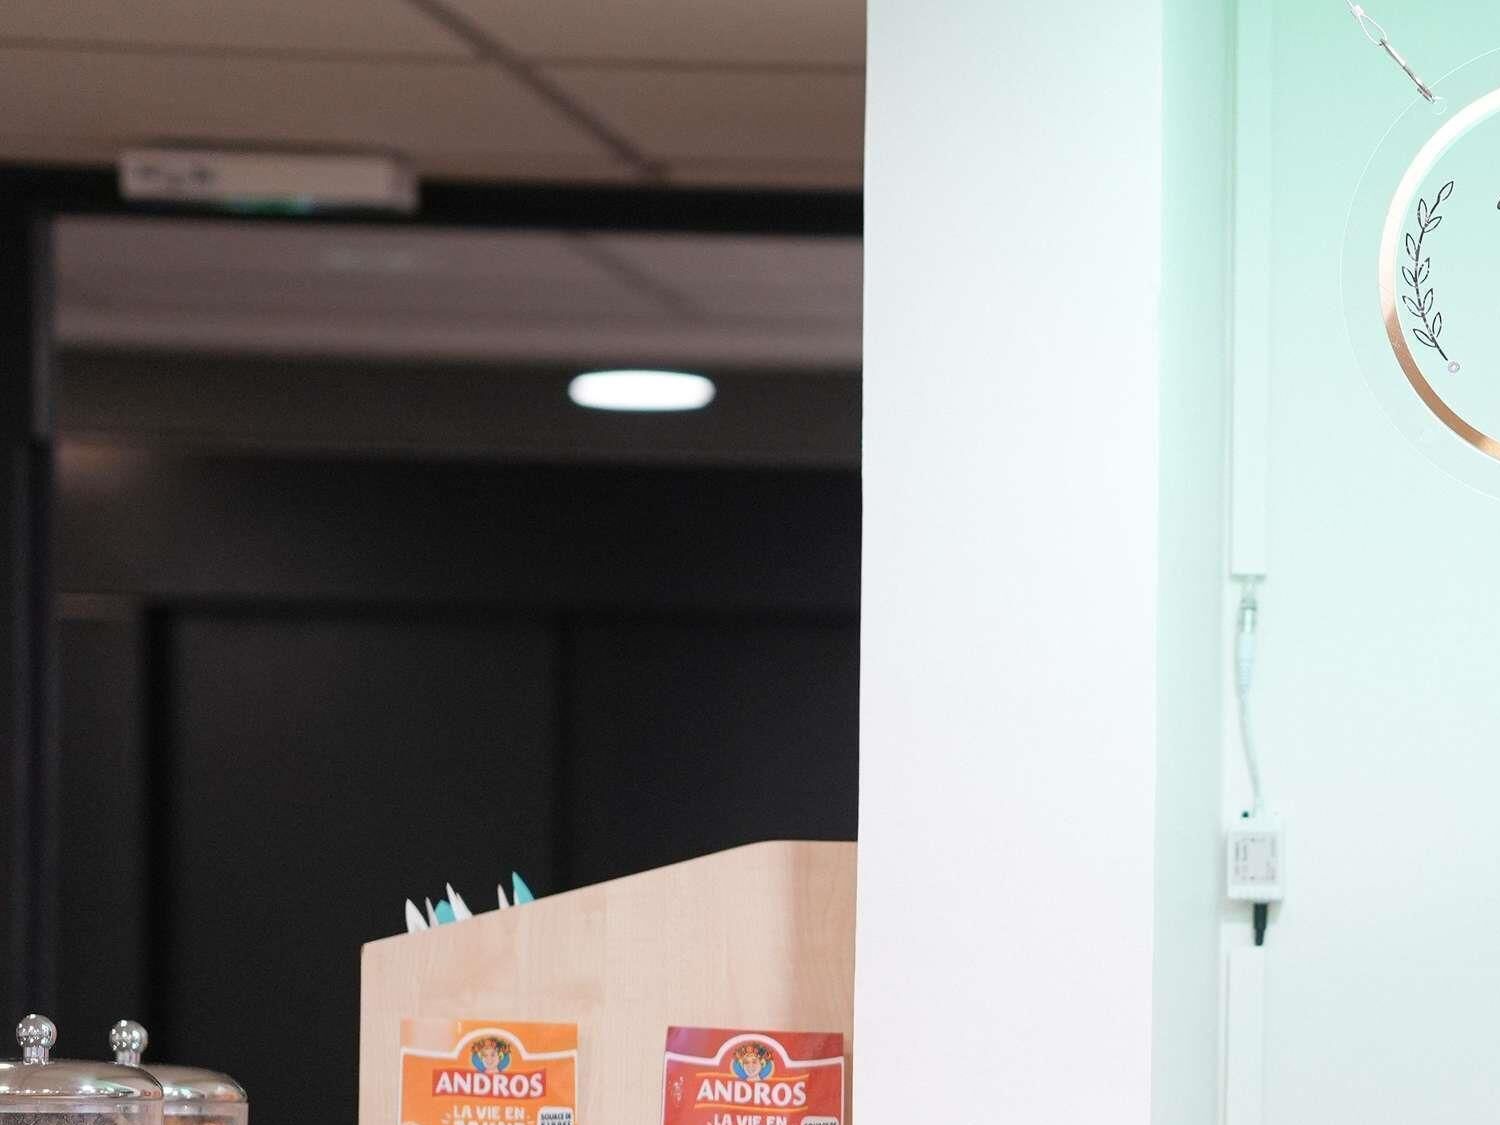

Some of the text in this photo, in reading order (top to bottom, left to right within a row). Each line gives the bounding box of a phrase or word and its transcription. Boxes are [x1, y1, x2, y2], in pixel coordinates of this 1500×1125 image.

[435, 1072, 544, 1098] ANDROS
[696, 1078, 807, 1106] ANDROS
[453, 1104, 525, 1120] LA VIE EN
